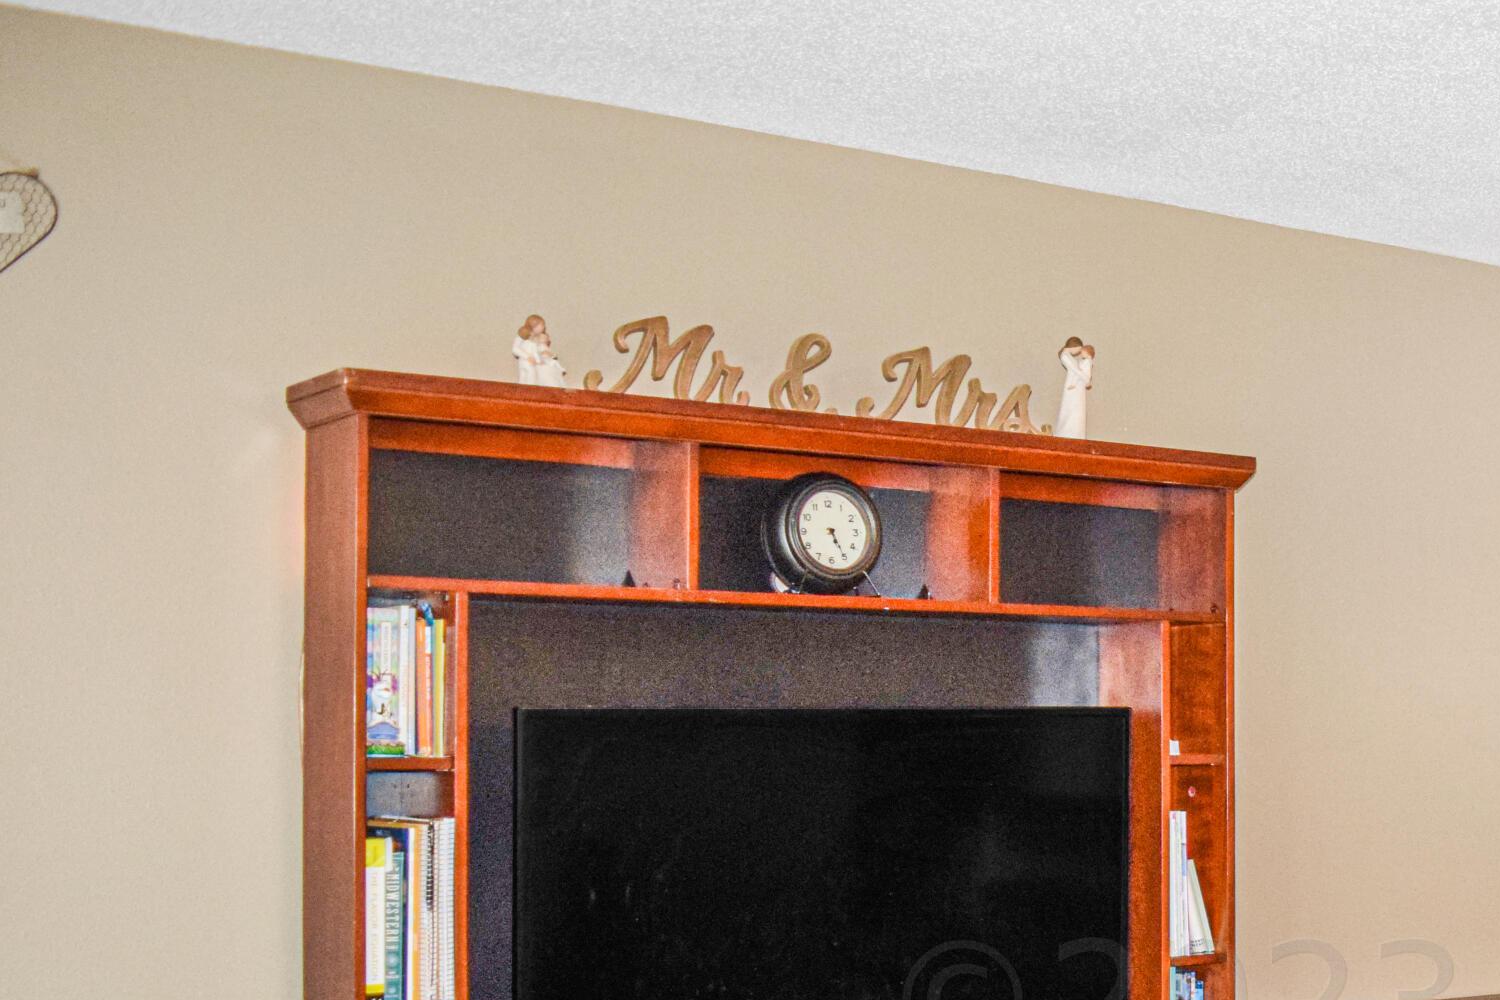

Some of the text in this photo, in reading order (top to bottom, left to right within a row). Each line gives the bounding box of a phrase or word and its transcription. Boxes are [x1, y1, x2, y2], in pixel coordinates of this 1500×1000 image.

[824, 500, 833, 509] 12
[803, 513, 812, 522] 10
[385, 873, 400, 943] MIDWESTERN
